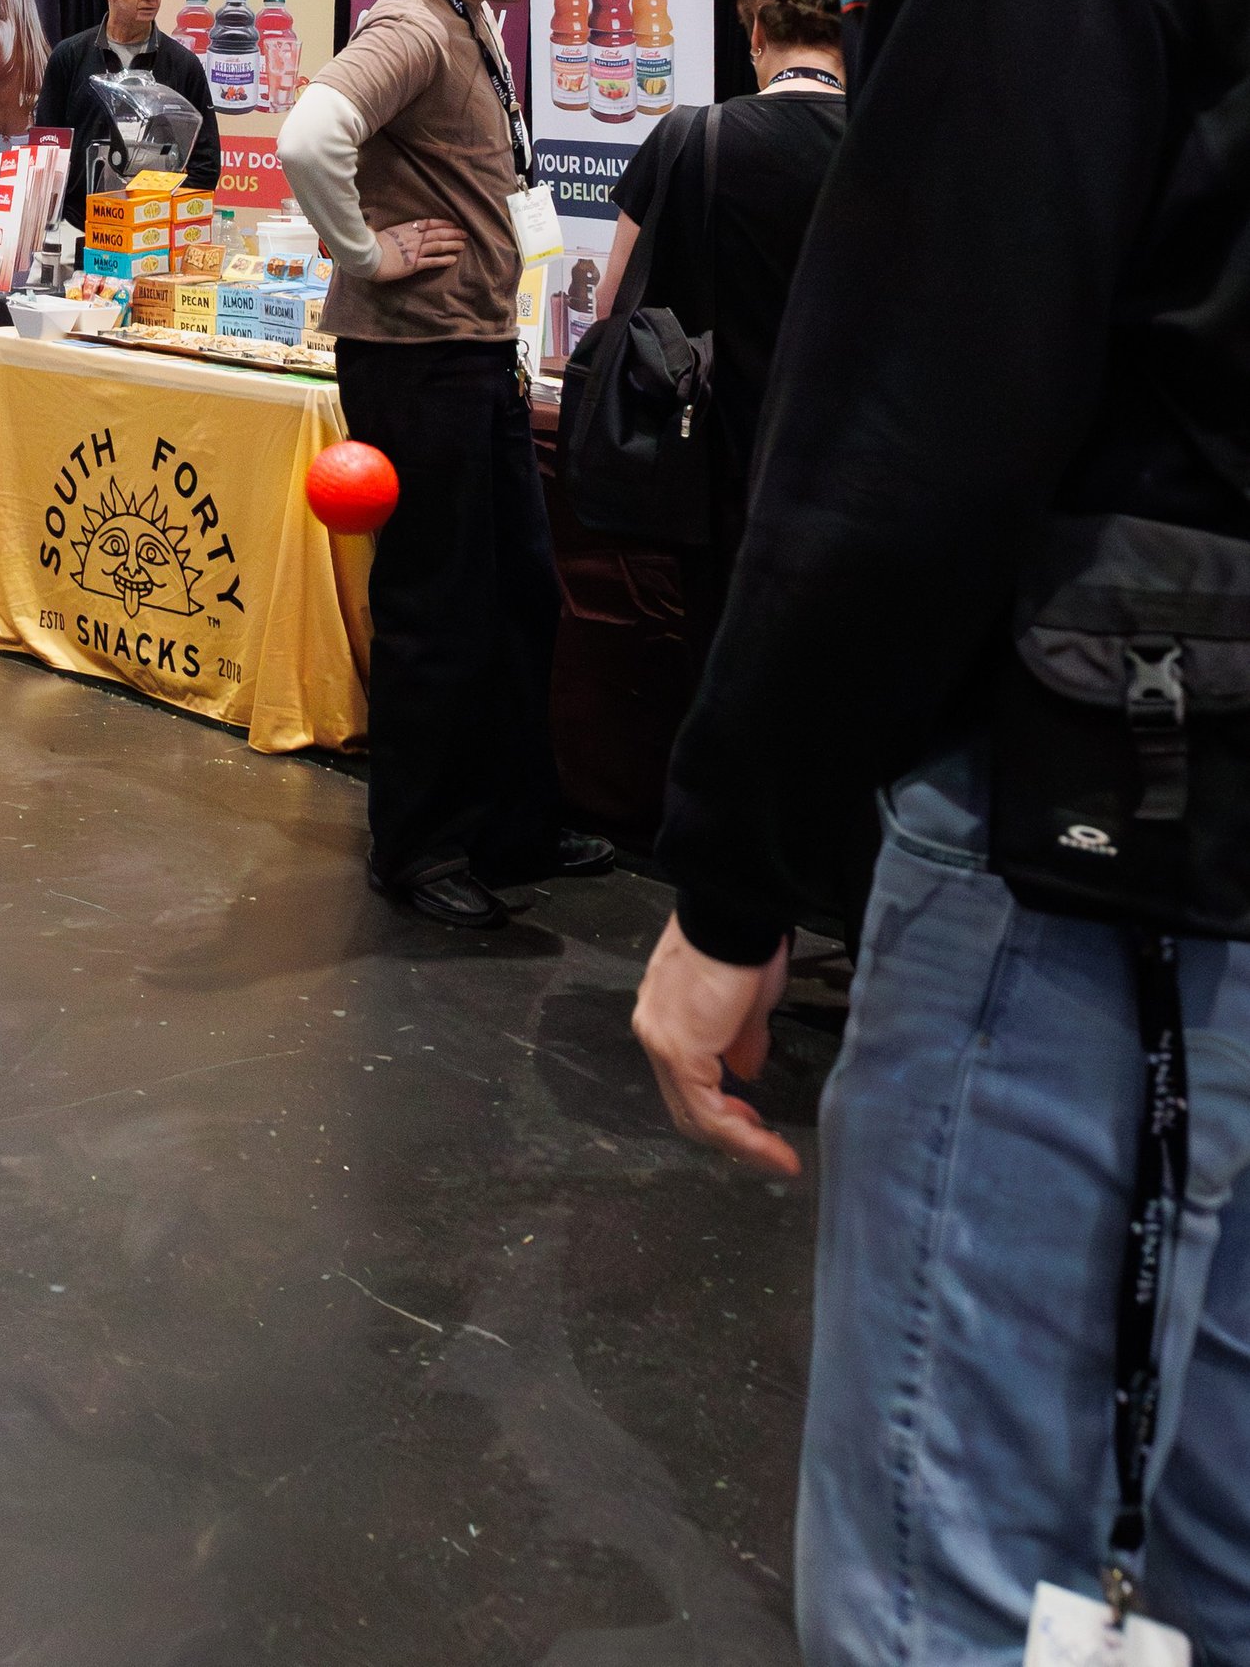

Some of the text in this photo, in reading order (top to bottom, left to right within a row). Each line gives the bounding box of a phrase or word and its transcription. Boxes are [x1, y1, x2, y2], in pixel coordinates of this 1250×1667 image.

[220, 150, 245, 168] ILY
[536, 153, 630, 177] YOUR DAILY
[220, 174, 259, 192] OUS
[559, 181, 616, 203] DELICI
[93, 204, 125, 219] MANGO
[92, 232, 123, 247] MANGO
[93, 257, 119, 269] MANGO
[181, 294, 210, 309] PECAN
[222, 294, 254, 310] ALMOND
[264, 303, 294, 321] MACADAMIA
[39, 427, 246, 615] SOUTH FORTY
[39, 610, 242, 684] ESTD SNACKS 2018
